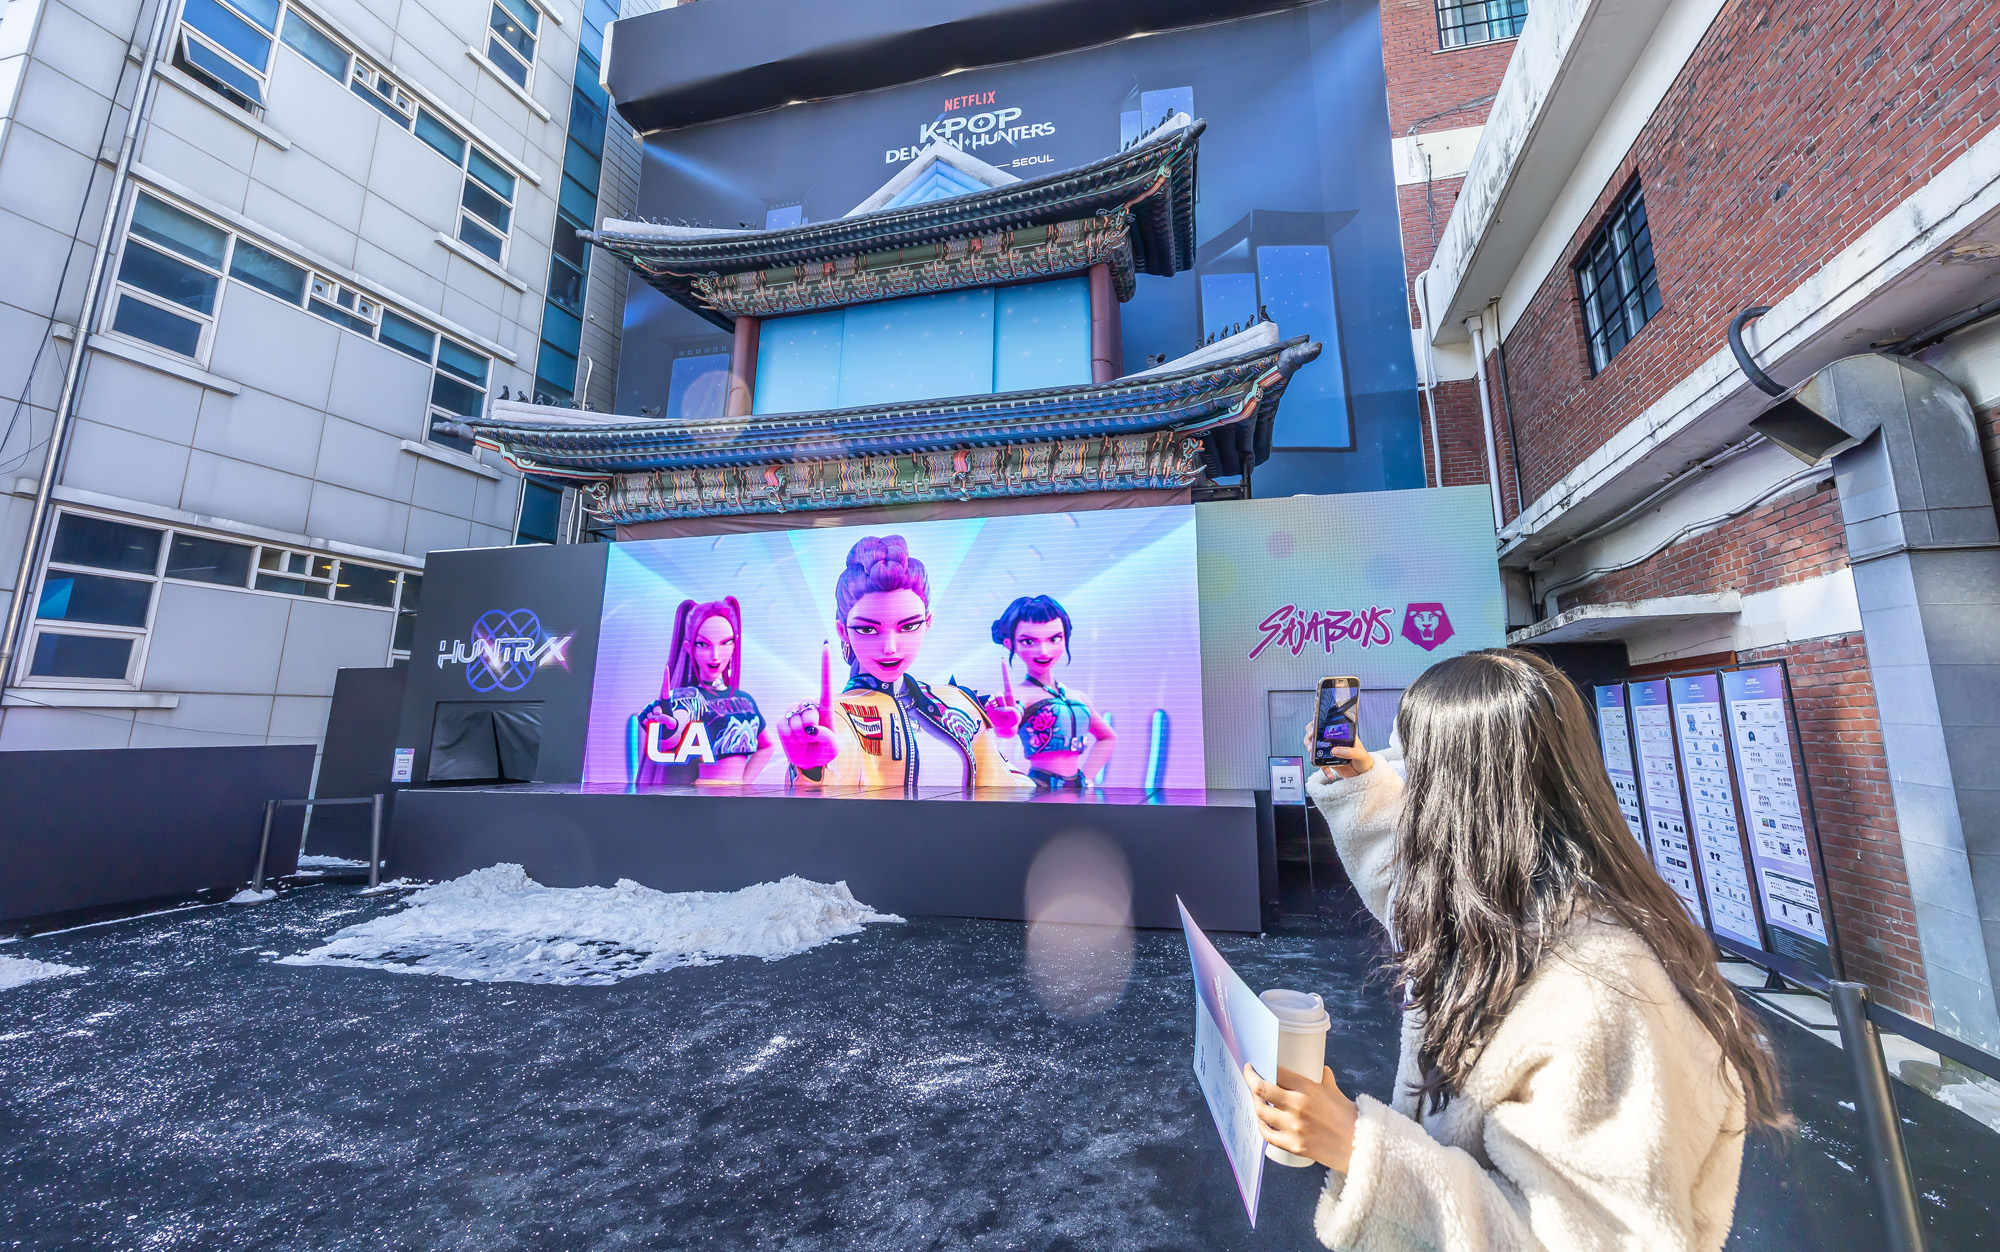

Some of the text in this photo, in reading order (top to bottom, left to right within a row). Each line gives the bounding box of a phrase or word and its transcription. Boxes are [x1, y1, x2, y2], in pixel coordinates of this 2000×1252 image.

[944, 91, 996, 112] NETFLIX
[885, 121, 1056, 164] DEMN HUNTERS
[1012, 154, 1055, 168] SEOUL
[646, 721, 716, 764] LA
[1279, 776, 1294, 784] 입구
